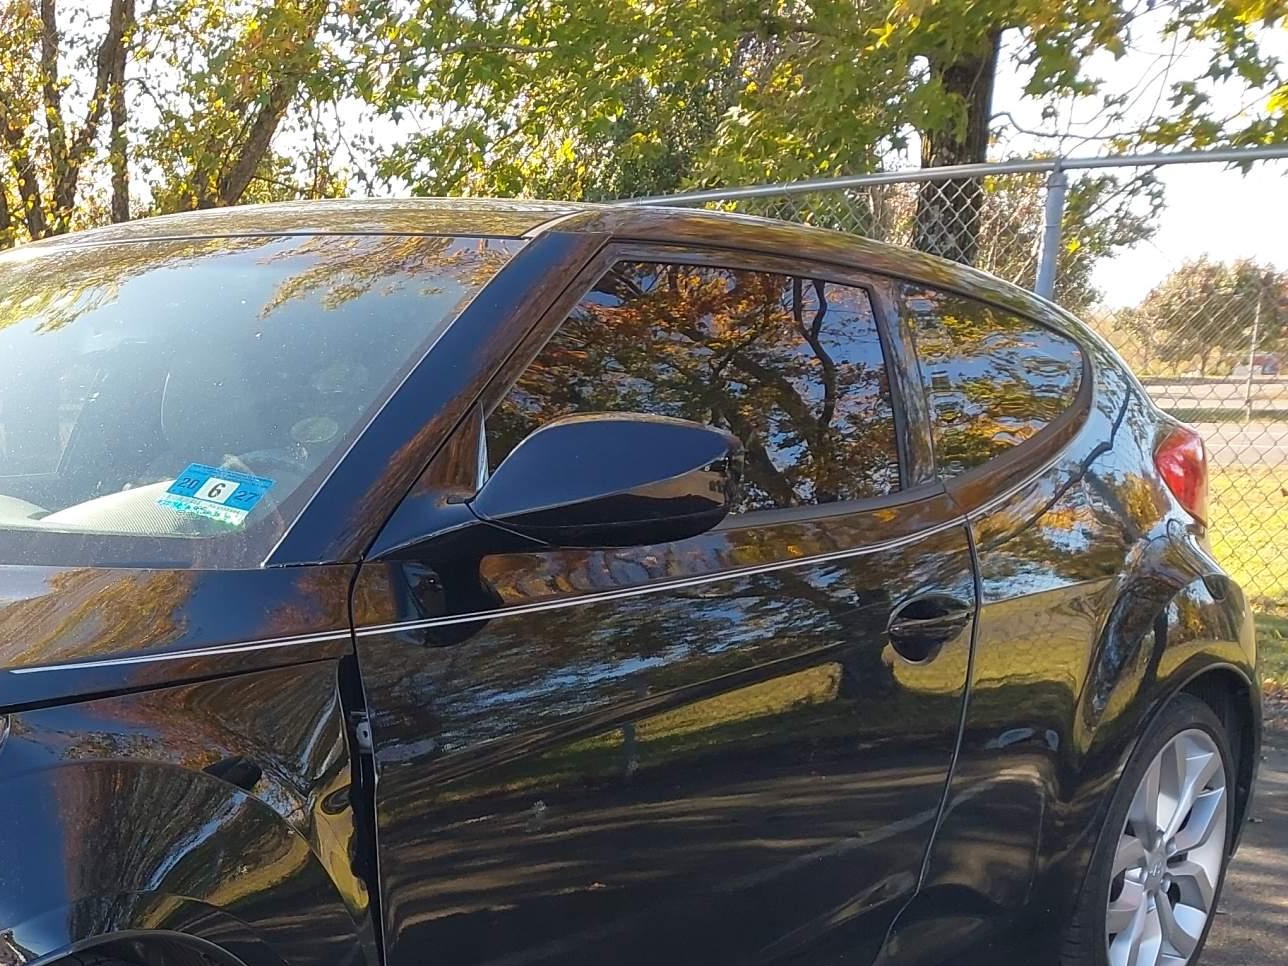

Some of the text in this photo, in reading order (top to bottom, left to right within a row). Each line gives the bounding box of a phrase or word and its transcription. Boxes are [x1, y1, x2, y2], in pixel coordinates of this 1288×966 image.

[178, 477, 259, 502] 20 6 27
